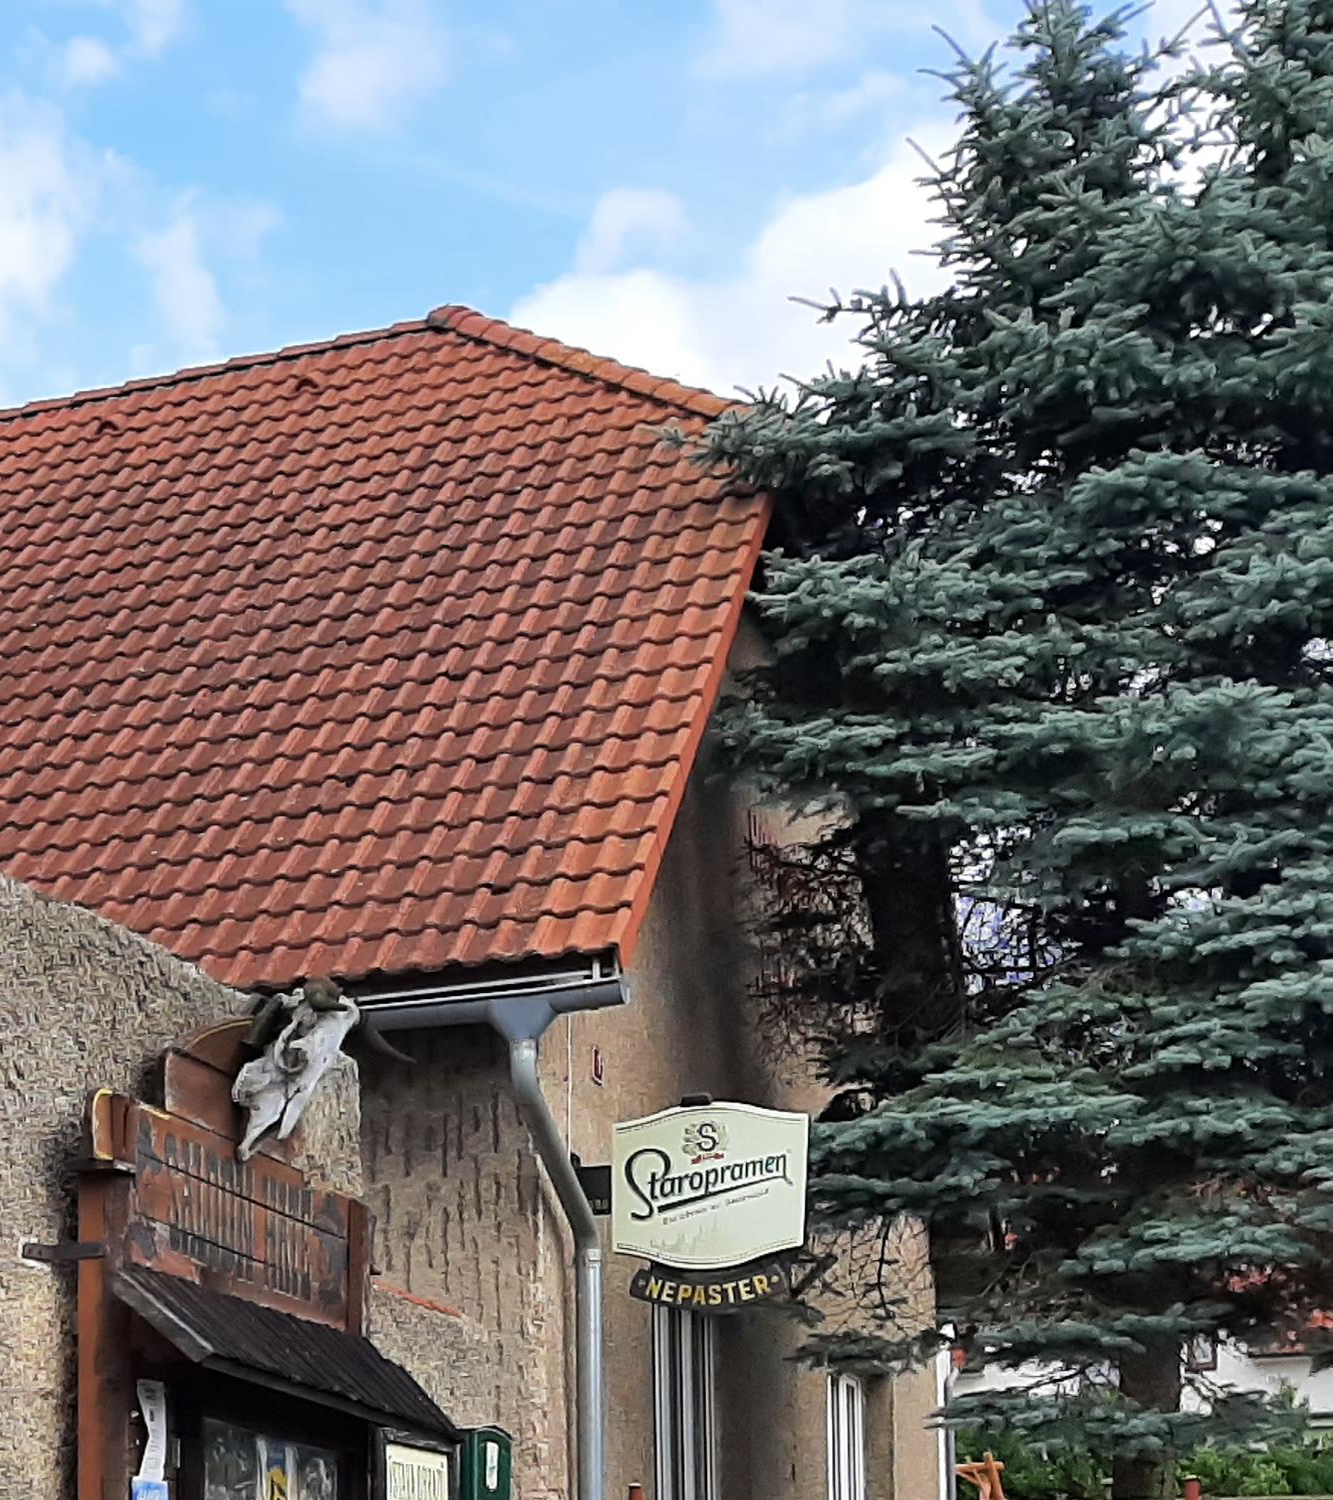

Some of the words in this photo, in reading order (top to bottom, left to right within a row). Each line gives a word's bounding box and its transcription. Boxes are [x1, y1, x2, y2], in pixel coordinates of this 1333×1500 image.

[696, 1122, 719, 1152] S
[624, 1147, 793, 1221] Staropramen
[645, 1274, 771, 1306] NEPASTER
